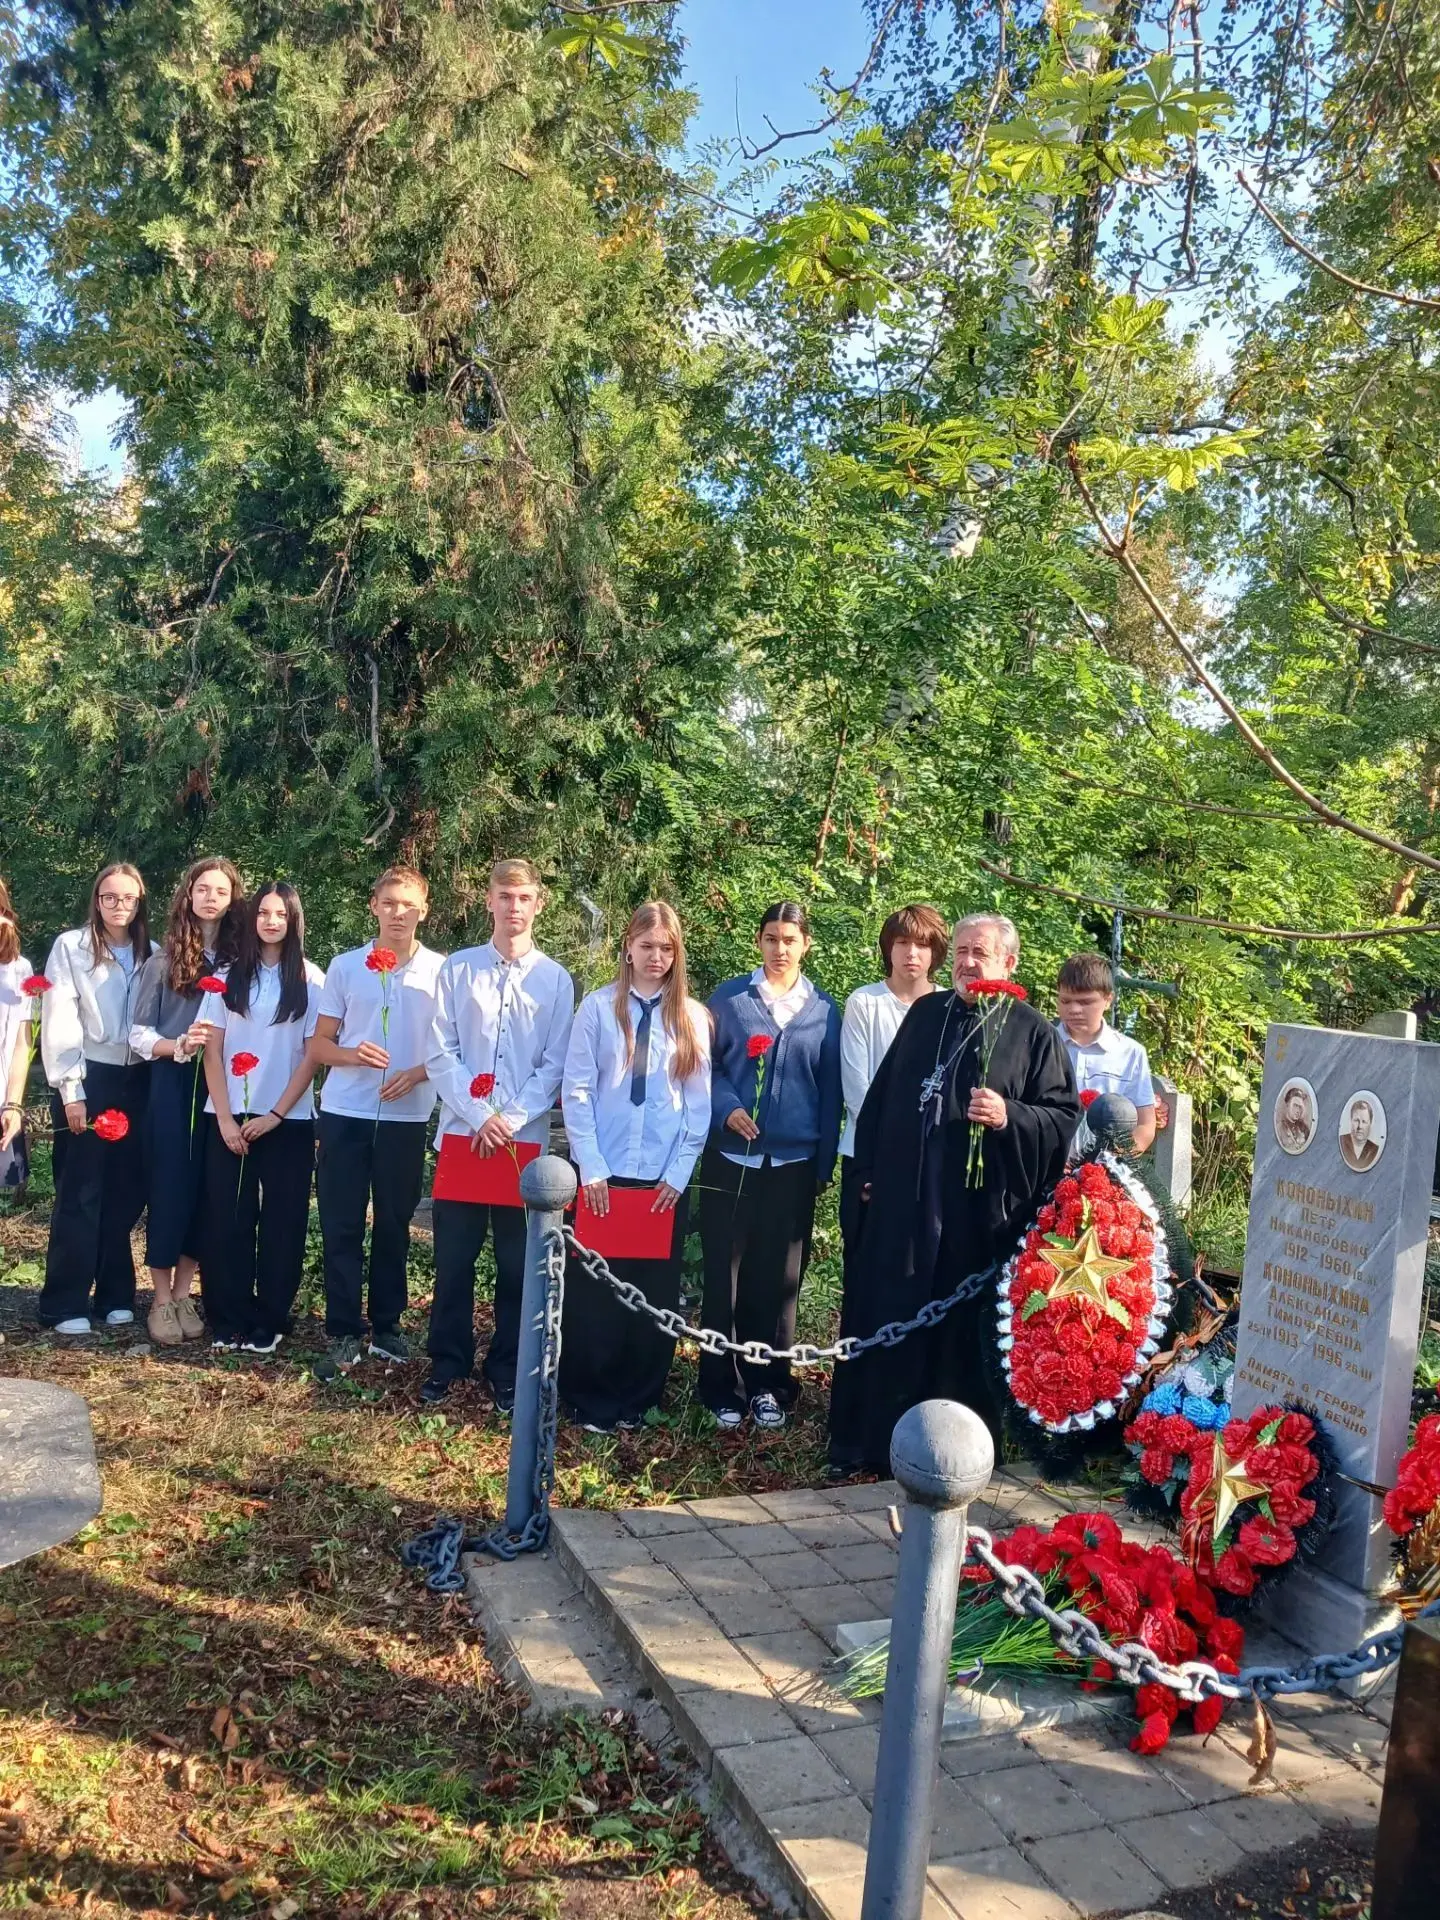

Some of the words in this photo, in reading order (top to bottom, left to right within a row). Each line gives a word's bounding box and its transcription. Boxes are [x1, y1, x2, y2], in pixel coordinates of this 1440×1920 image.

[1267, 1302, 1361, 1352] ТИМОФЕЕВНА
[1270, 1285, 1359, 1332] АЛЕКСАНДРА
[1239, 1370, 1278, 1393] БУДЕТ
[1325, 1409, 1368, 1437] ВЕЧНО
[1247, 1357, 1295, 1387] ПАМЯТЬ
[1315, 1389, 1366, 1419] ГЕРОЯХ
